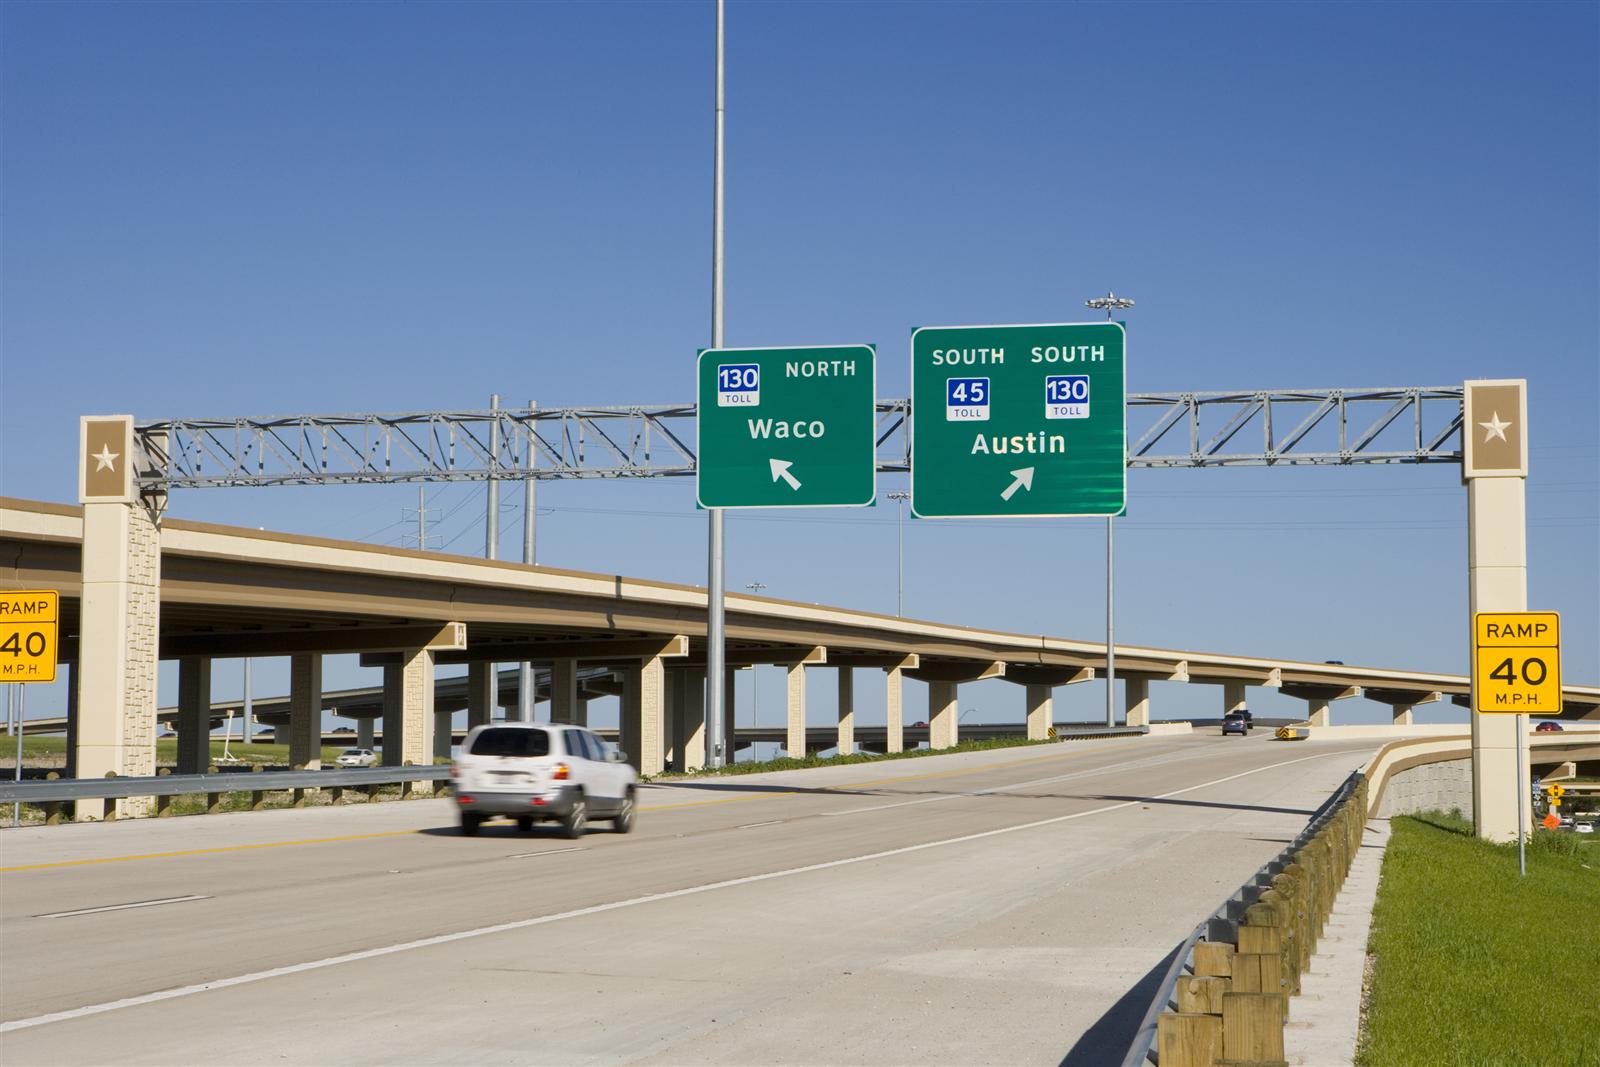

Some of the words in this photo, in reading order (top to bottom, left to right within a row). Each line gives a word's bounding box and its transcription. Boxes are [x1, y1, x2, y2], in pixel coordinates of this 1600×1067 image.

[932, 348, 1005, 366] SOUTH
[1031, 345, 1105, 363] SOUTH
[786, 360, 856, 378] NORTH
[719, 368, 758, 389] 130
[725, 394, 752, 404] TOLL
[952, 382, 985, 402] 45
[1047, 379, 1089, 401] 130
[954, 408, 982, 418] TOLL
[1053, 406, 1081, 416] TOLL
[748, 418, 825, 439] Waco
[971, 431, 1065, 455] Austin
[0, 601, 48, 614] RAMP
[1487, 623, 1548, 638] RAMP
[0, 632, 46, 657] 40
[3, 664, 40, 674] M.P.H.
[1489, 657, 1547, 686] 40
[1495, 694, 1542, 705] M.P.H.
